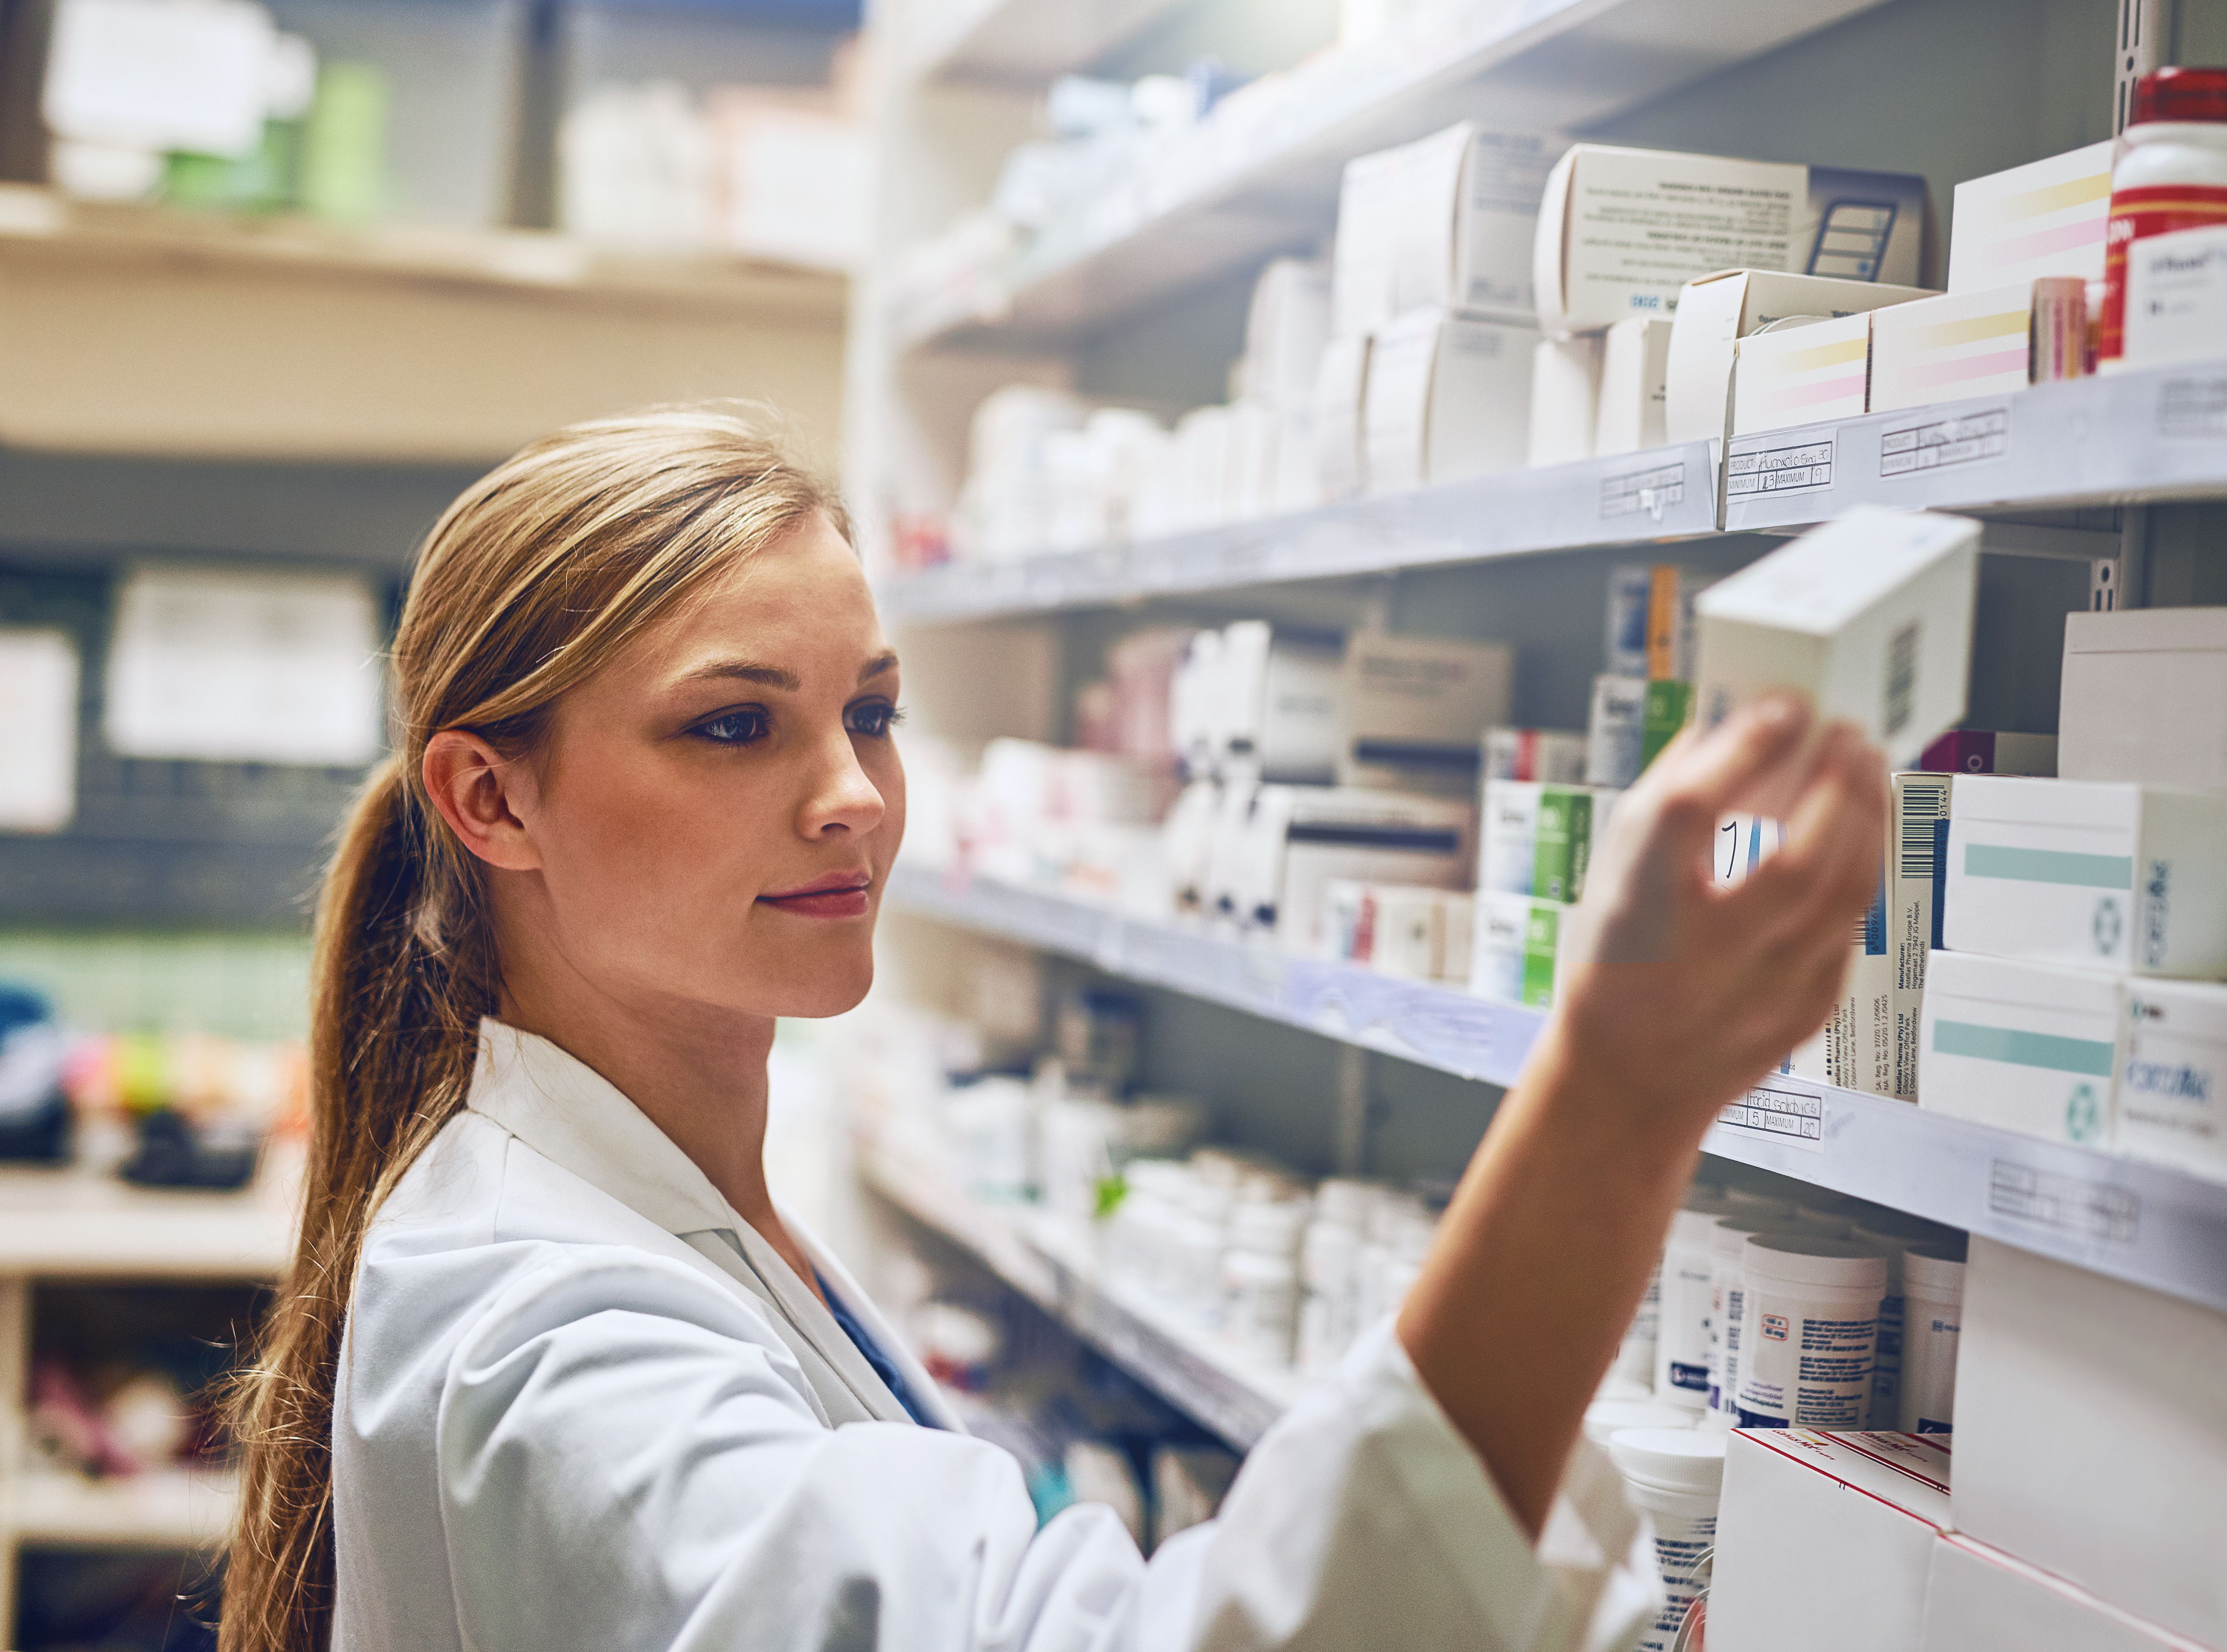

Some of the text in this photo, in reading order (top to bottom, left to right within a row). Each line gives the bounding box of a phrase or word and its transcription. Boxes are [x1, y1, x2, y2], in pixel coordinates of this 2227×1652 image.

[1729, 478, 1755, 490] MINIMUM
[1777, 472, 1805, 484] MAXIMUM
[1752, 1111, 1759, 1126] 5
[1766, 1115, 1794, 1129] MAXIMUM
[1803, 1123, 1814, 1136] 20
